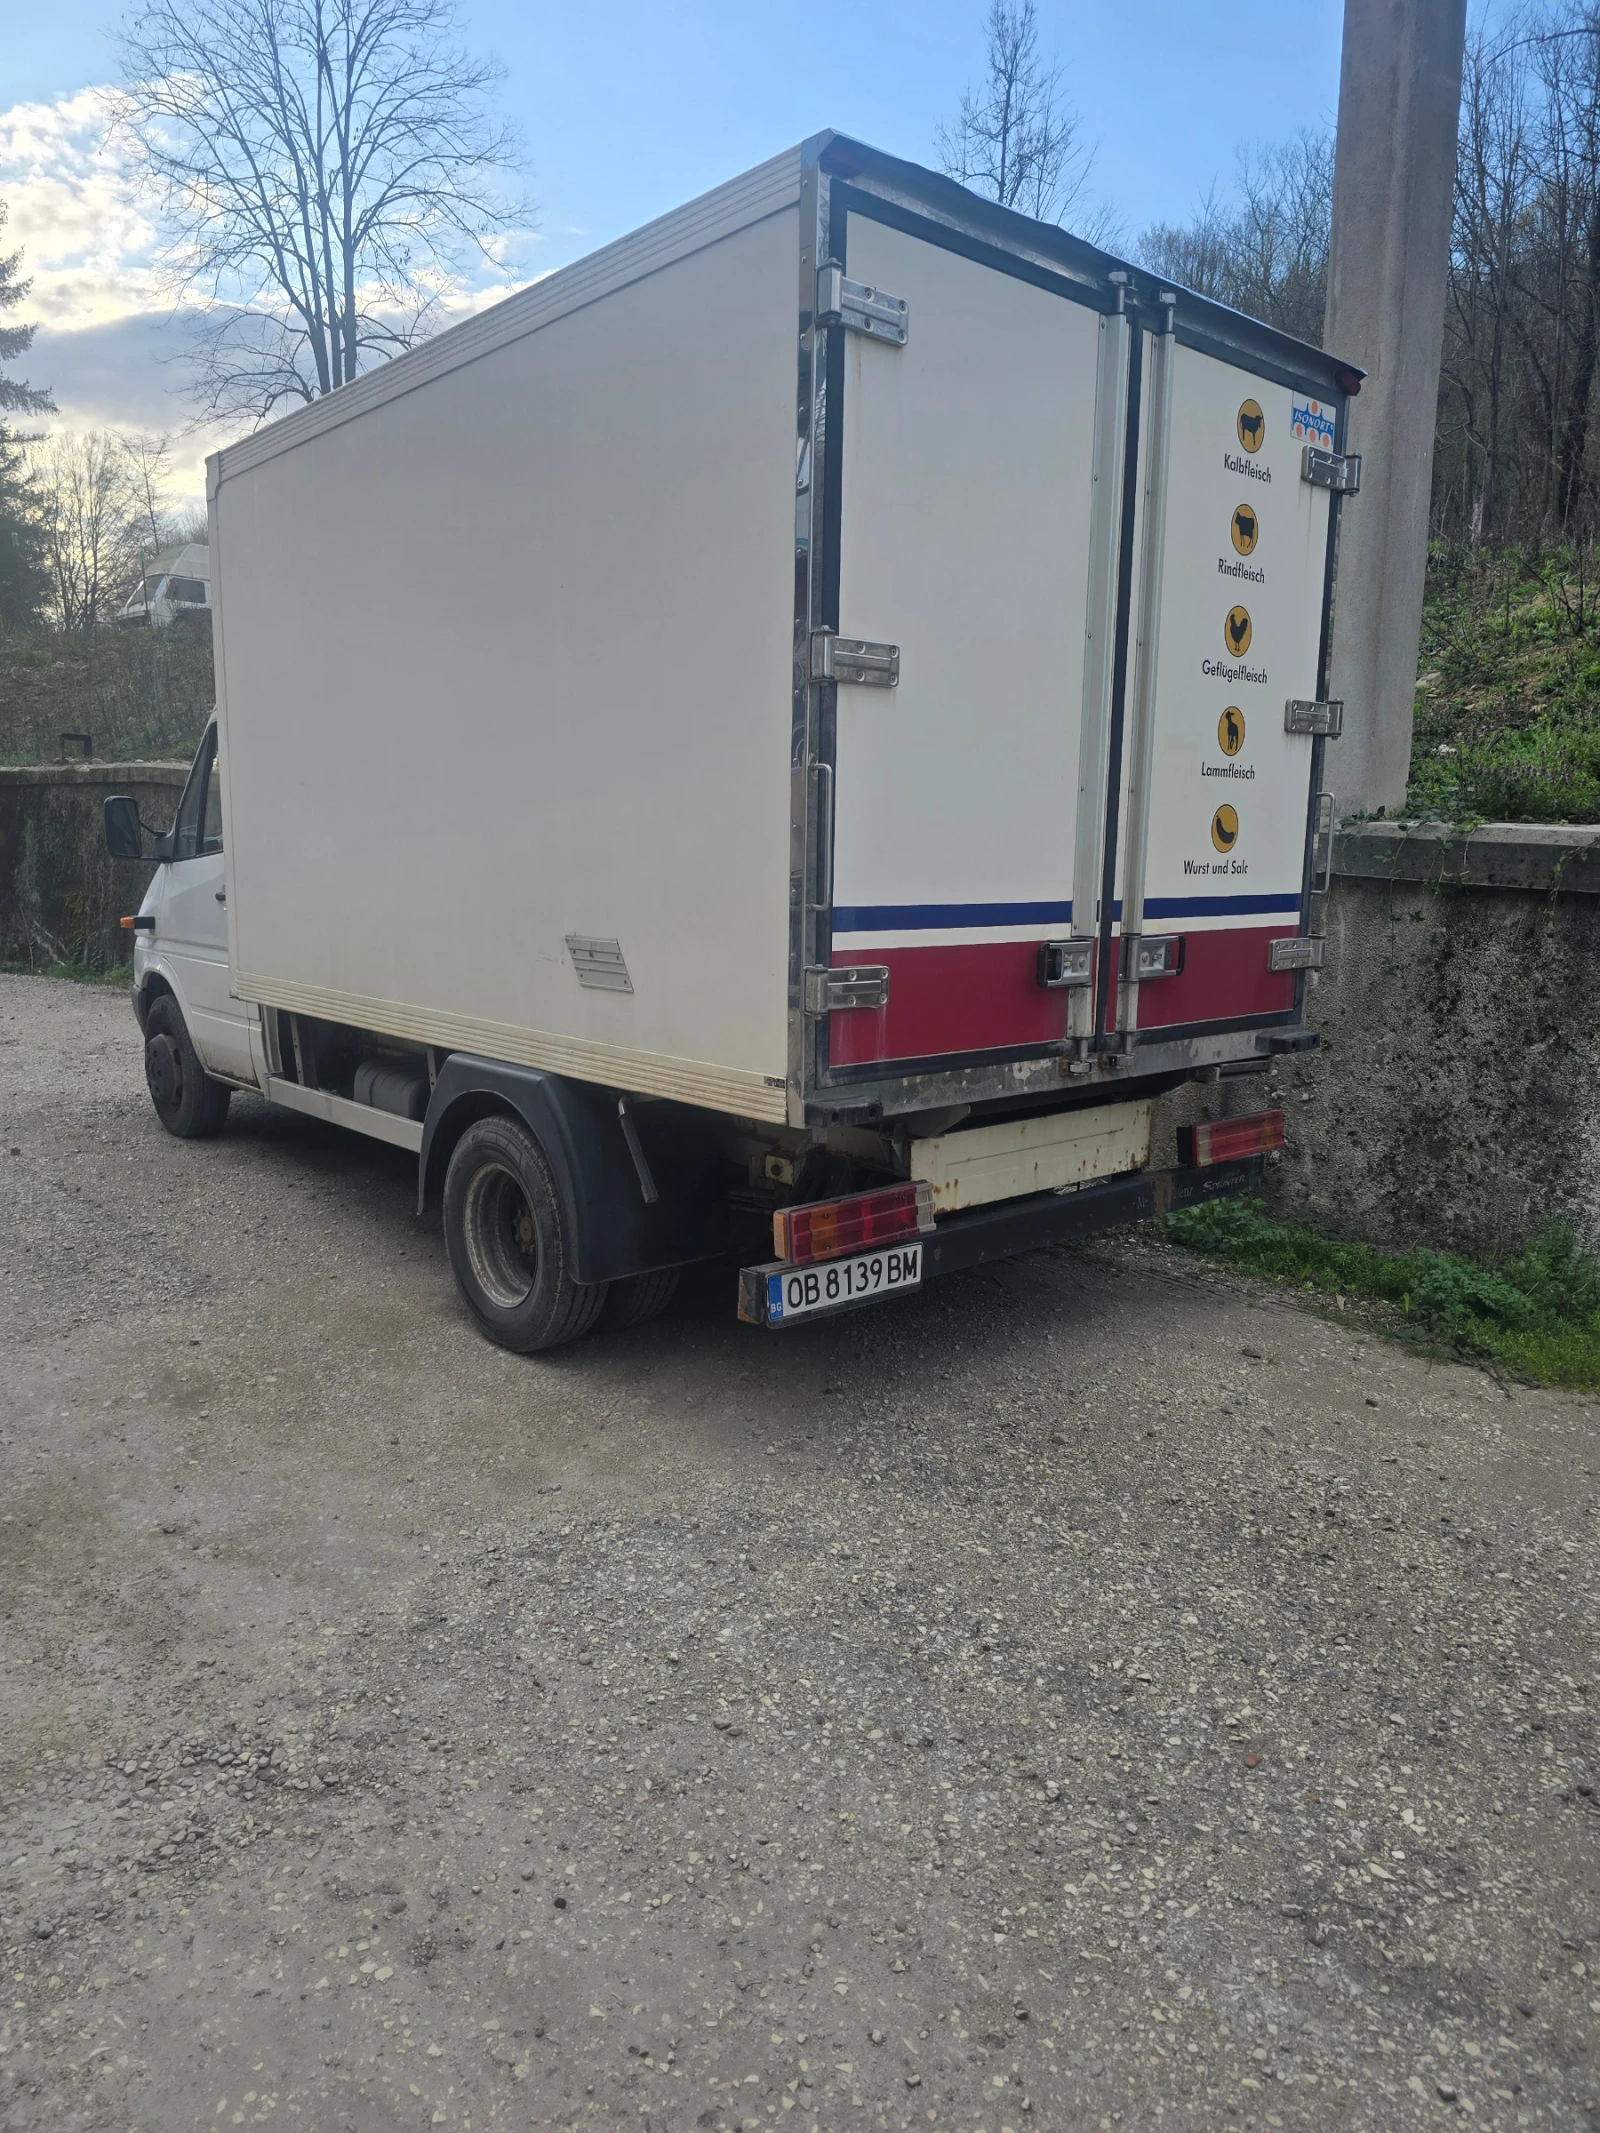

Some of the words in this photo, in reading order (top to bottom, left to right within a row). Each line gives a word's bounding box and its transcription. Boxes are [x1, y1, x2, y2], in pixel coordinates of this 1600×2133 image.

[1224, 453, 1272, 484] Kalbfleisch
[1218, 558, 1265, 583] Rindfleisch
[1202, 660, 1268, 684] Geflügelfleisch
[1202, 762, 1255, 780] Lammfleisch
[1183, 860, 1210, 875] Wurst
[1212, 860, 1229, 875] und
[770, 1302, 782, 1313] BG
